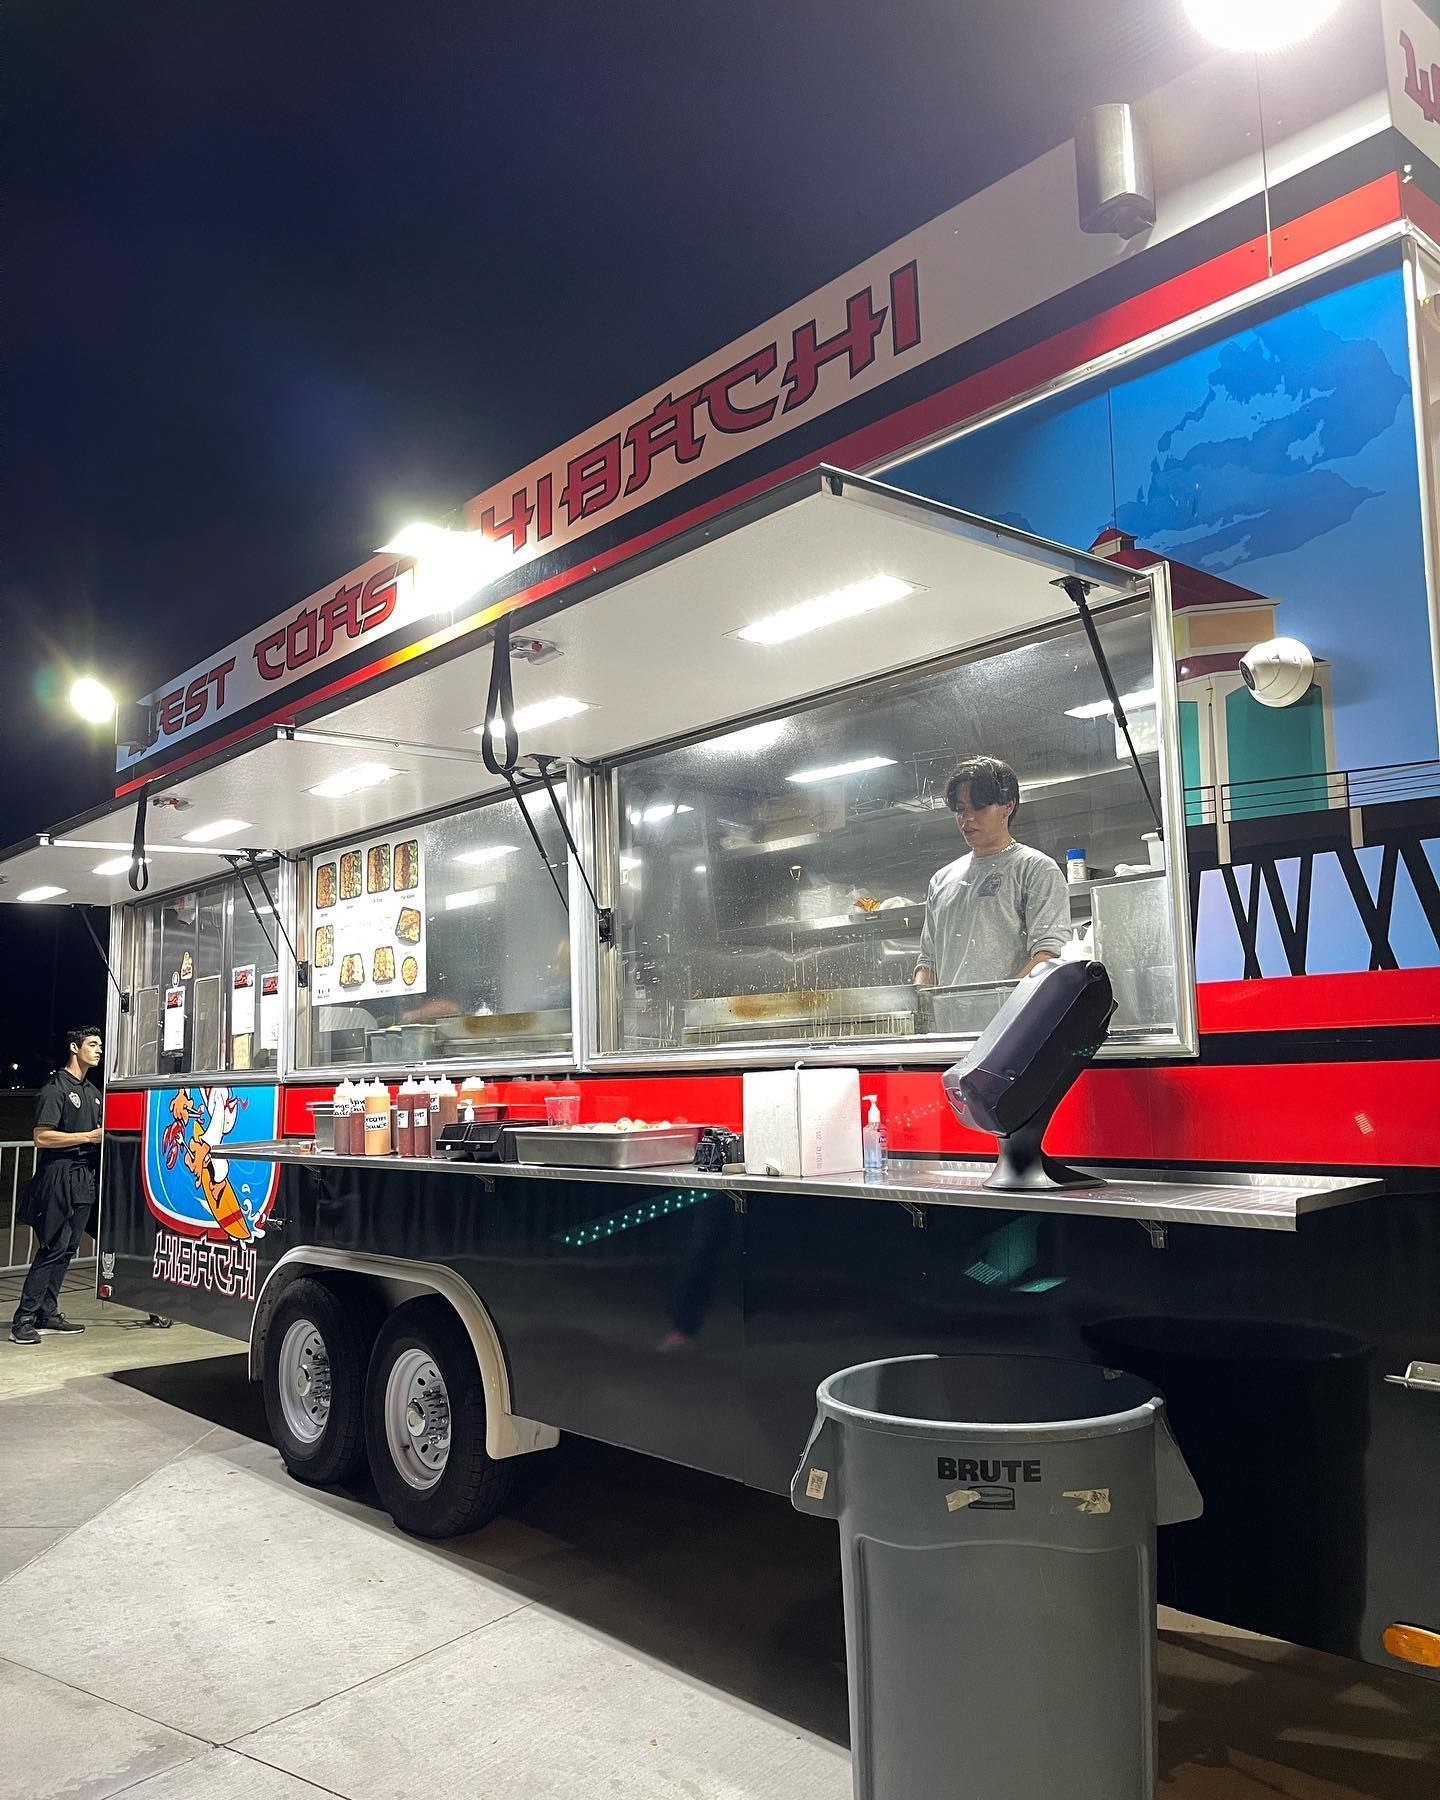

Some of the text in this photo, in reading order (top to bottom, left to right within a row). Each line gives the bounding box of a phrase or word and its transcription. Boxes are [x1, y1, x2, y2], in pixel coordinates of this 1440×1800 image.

[253, 560, 415, 681] COAS
[481, 259, 921, 553] HIBACHI
[152, 1229, 257, 1303] HIBACHI
[937, 1456, 1042, 1483] BRUTE
